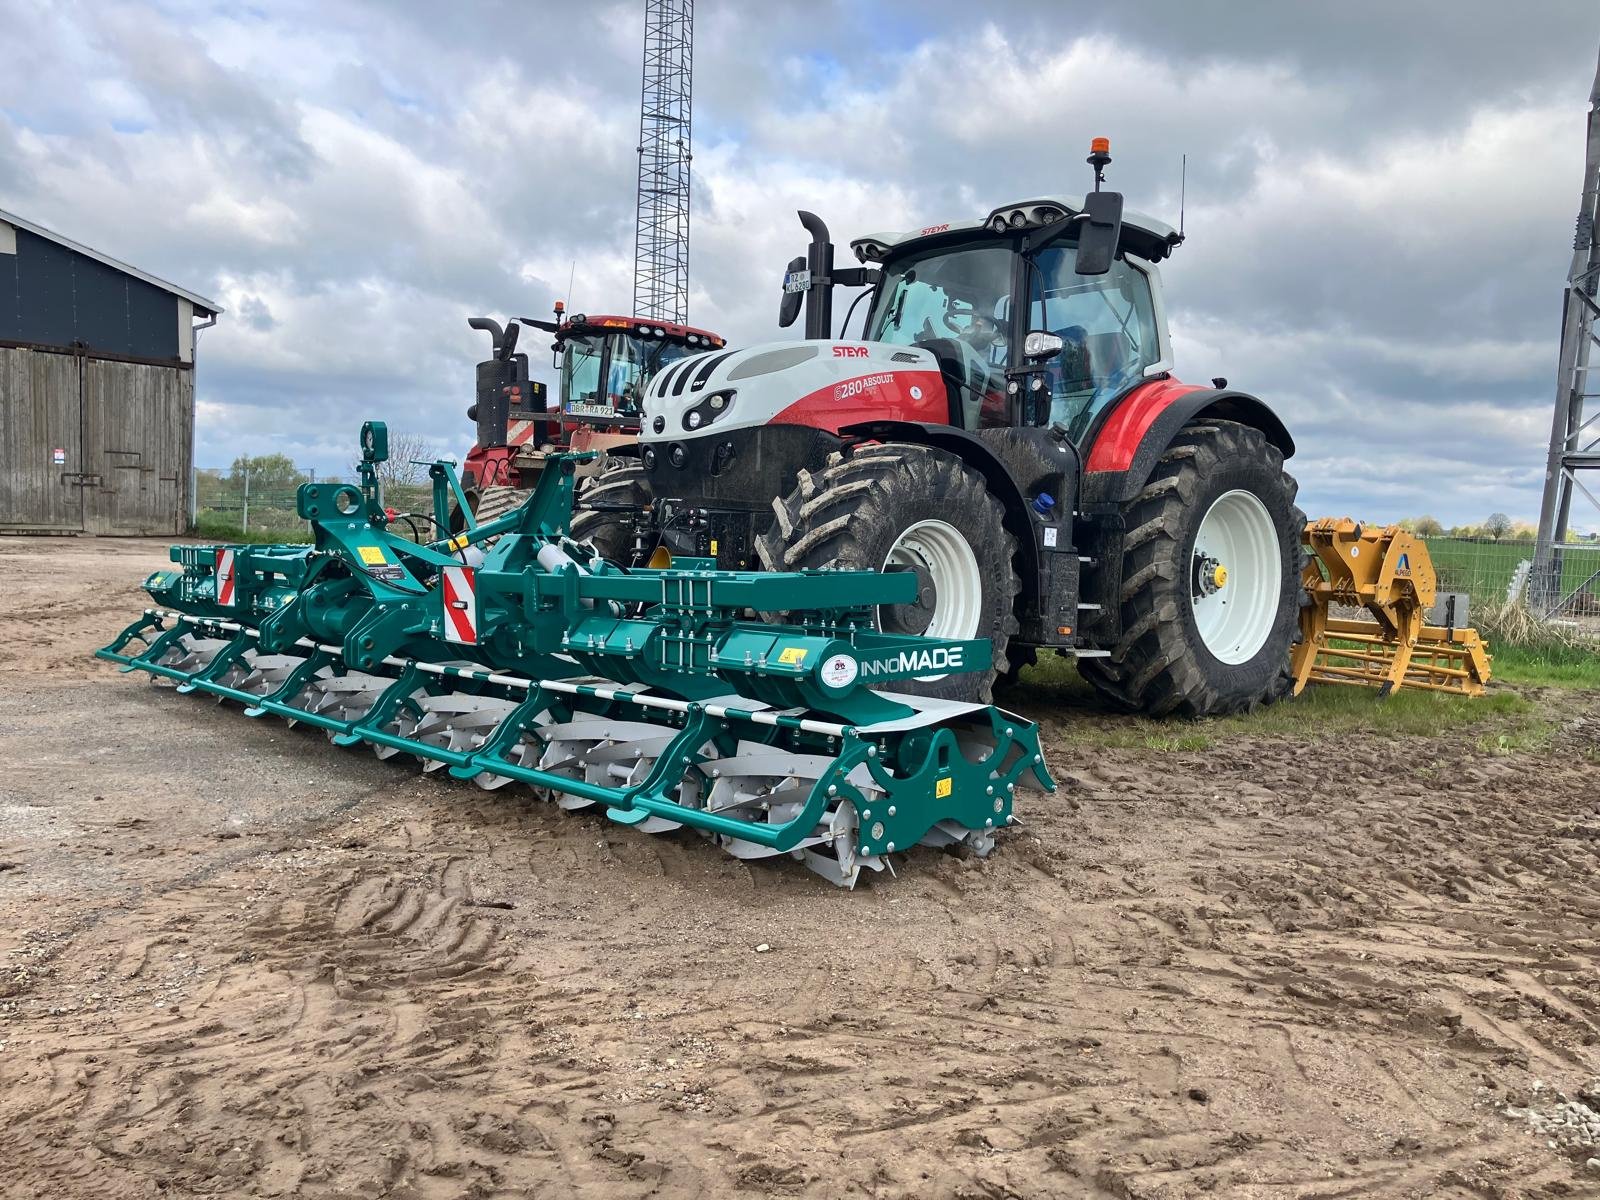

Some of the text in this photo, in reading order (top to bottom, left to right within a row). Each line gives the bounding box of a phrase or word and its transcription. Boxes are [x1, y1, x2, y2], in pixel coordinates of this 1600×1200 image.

[921, 224, 949, 236] STEYR
[832, 346, 869, 358] STEYR
[863, 374, 894, 388] ABSOLUT
[571, 404, 613, 416] DBR RA 921
